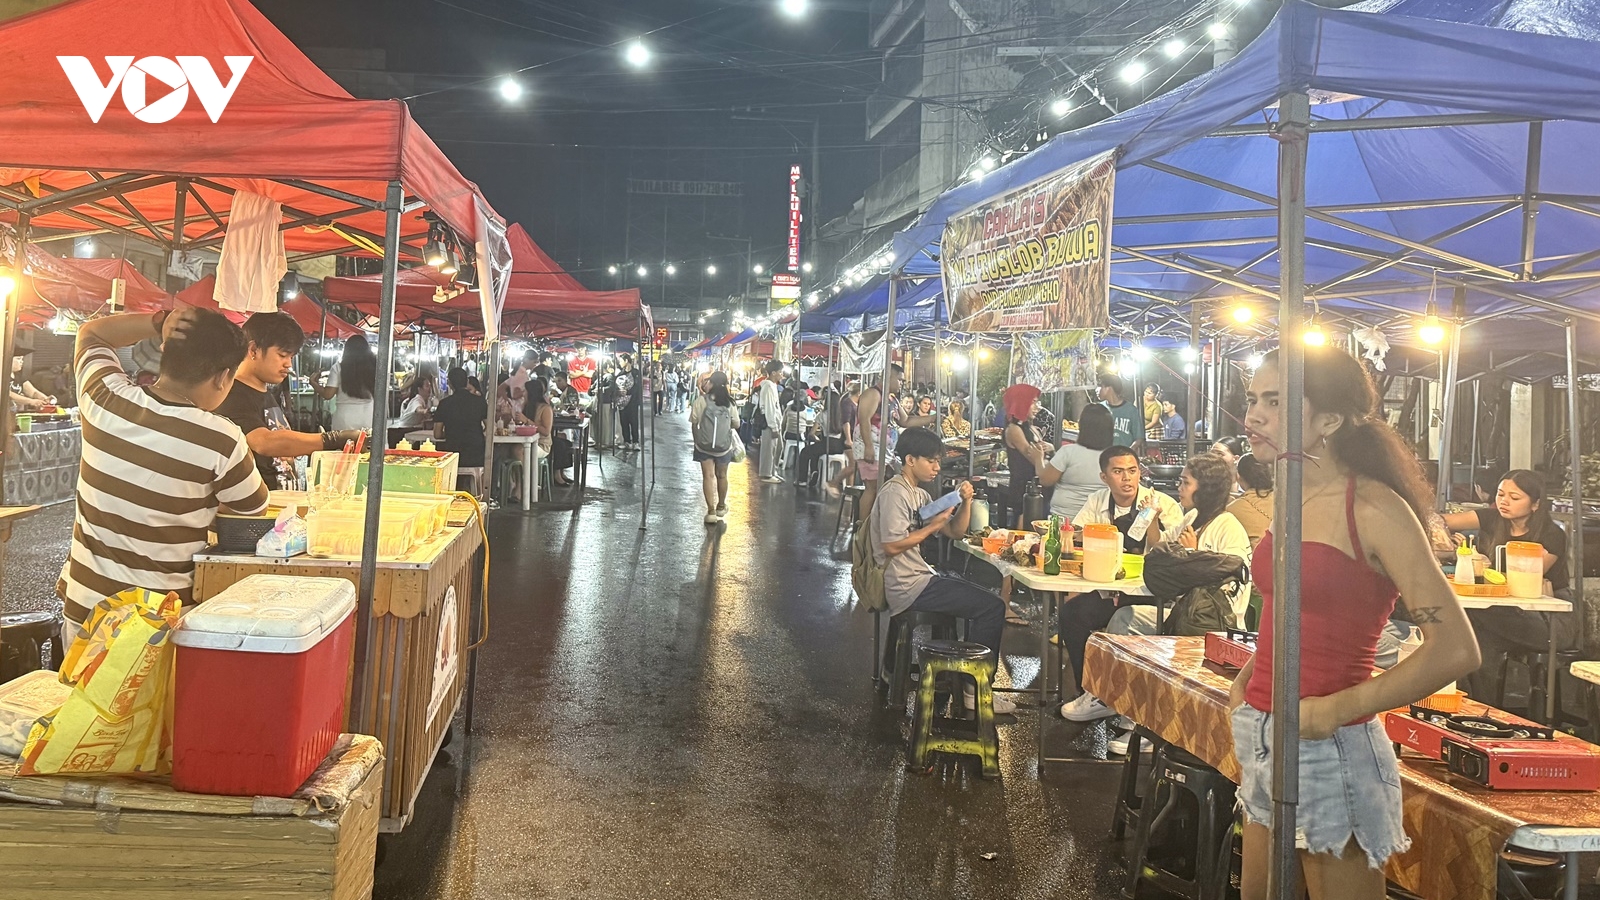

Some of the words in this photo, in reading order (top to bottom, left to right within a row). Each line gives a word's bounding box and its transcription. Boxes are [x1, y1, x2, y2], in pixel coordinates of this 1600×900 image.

[984, 192, 1046, 239] CARLA'S
[978, 239, 1045, 284] TUSLOB
[1044, 220, 1101, 271] BUWA
